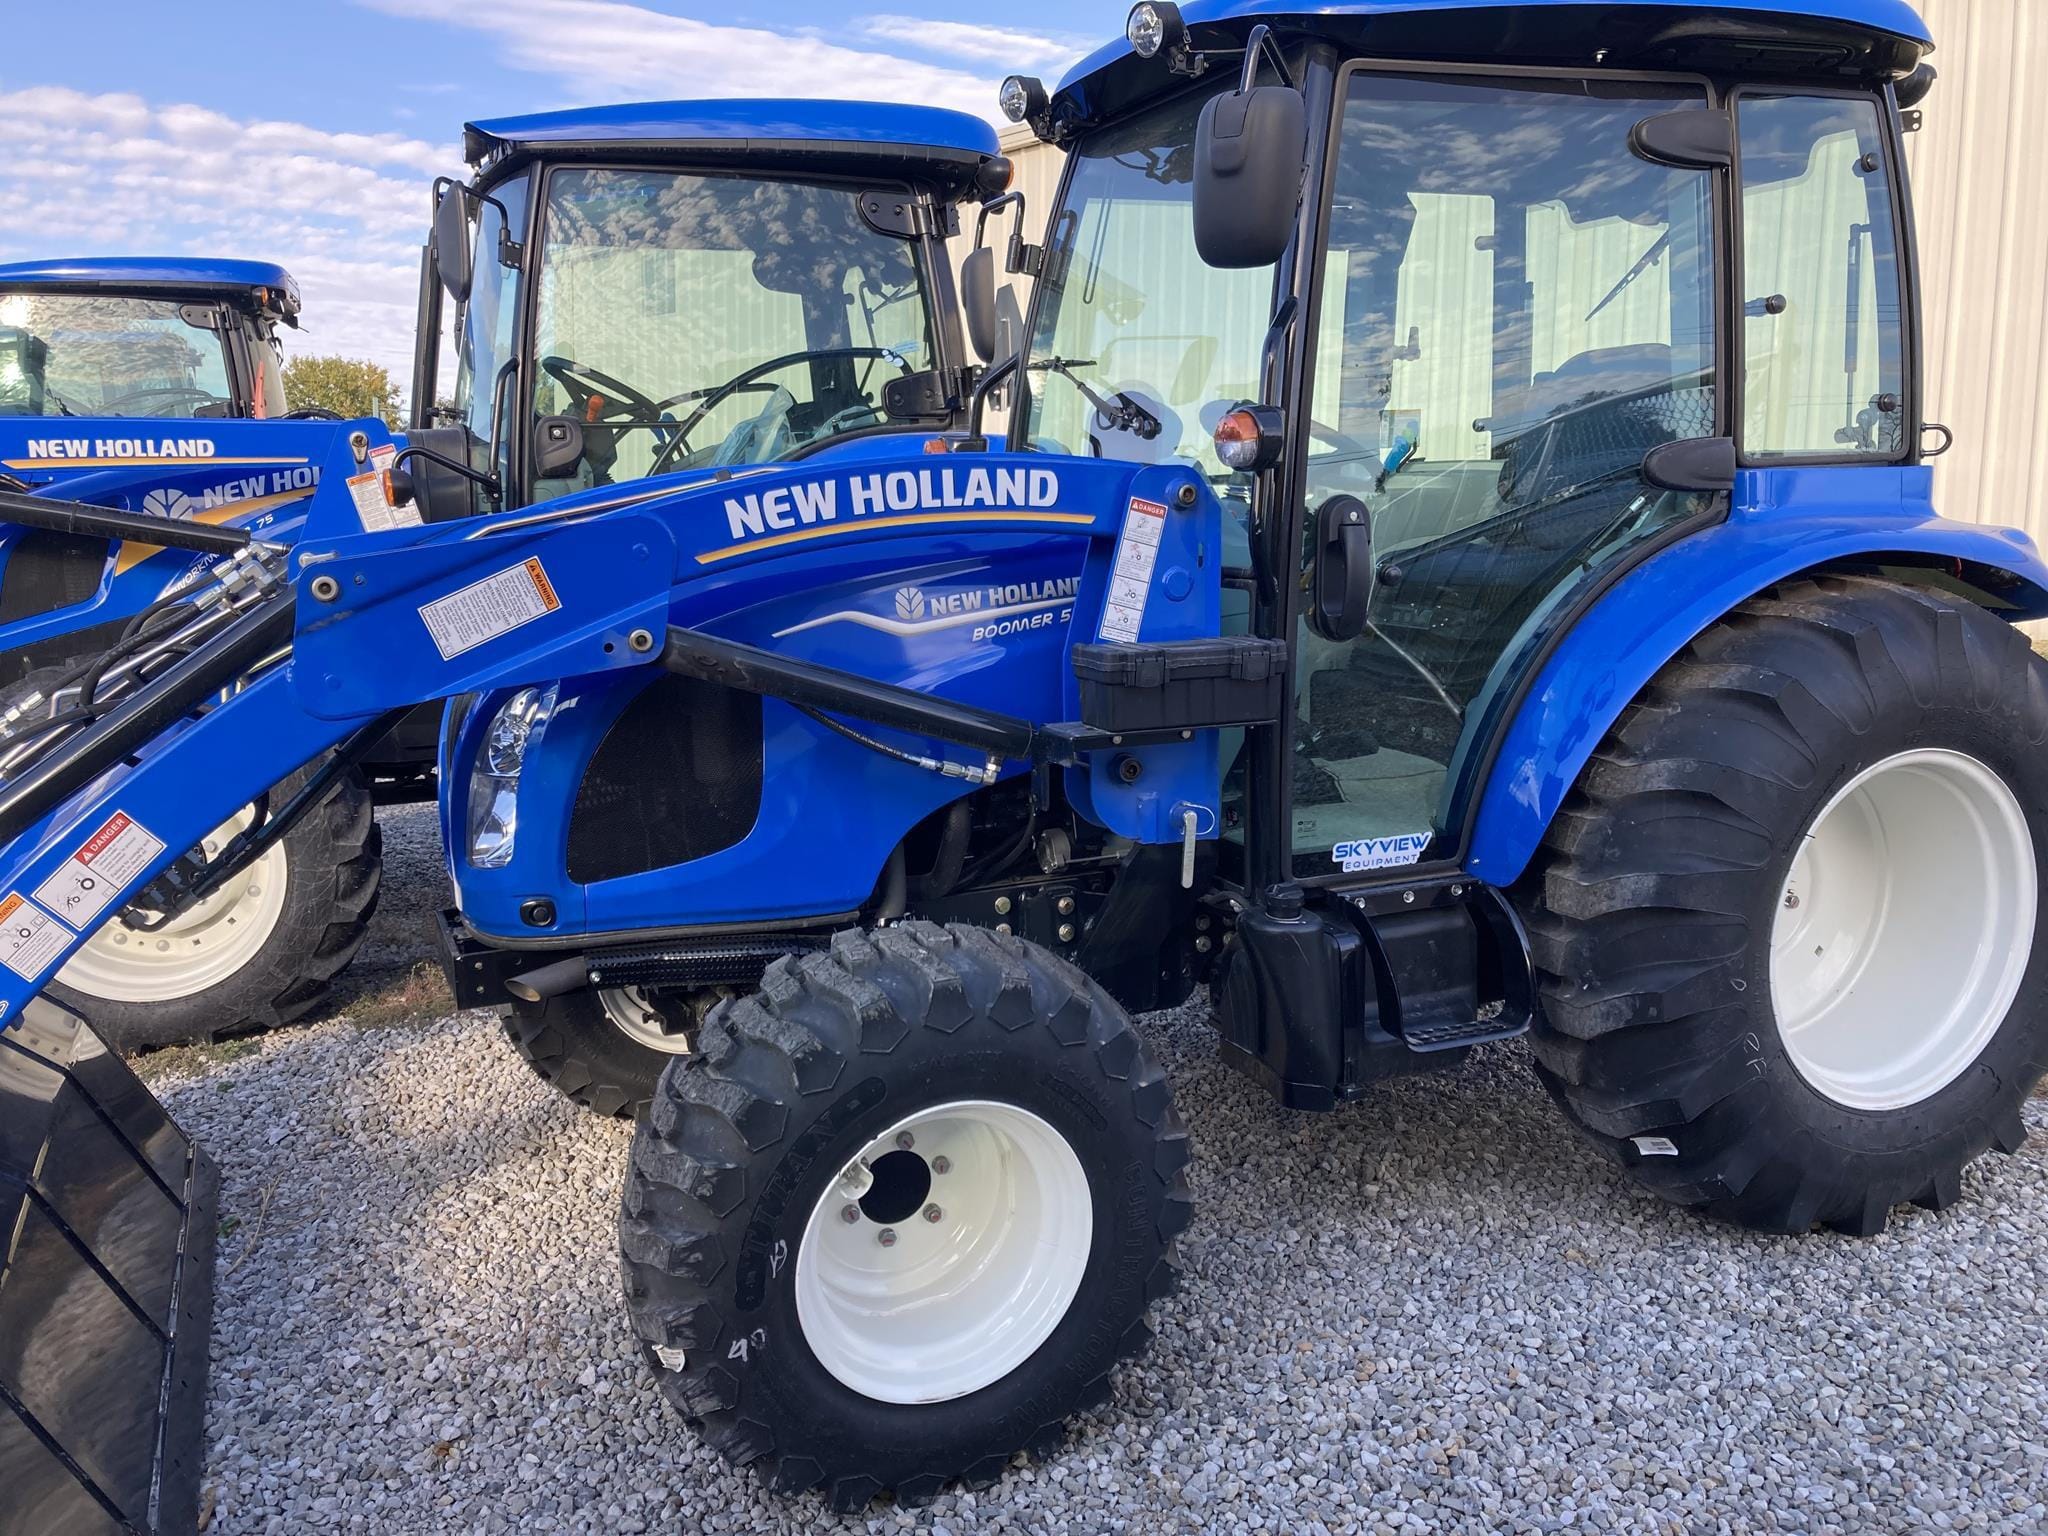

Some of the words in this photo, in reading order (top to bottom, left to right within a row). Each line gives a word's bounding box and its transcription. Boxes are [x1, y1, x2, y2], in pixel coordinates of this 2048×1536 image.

[27, 439, 89, 458] NEW
[95, 439, 215, 458] HOLLAND
[203, 475, 266, 509] NEW
[723, 479, 837, 540] NEW
[849, 468, 1060, 516] HOLLAND
[256, 513, 275, 529] 75
[1138, 504, 1165, 516] DANGER
[534, 572, 554, 606] WARNING
[931, 590, 982, 617] NEW
[972, 612, 1053, 642] BOOMER
[90, 818, 125, 852] DANGER
[1335, 834, 1430, 859] SKYVIEW
[1345, 854, 1418, 870] EQUIPMENT
